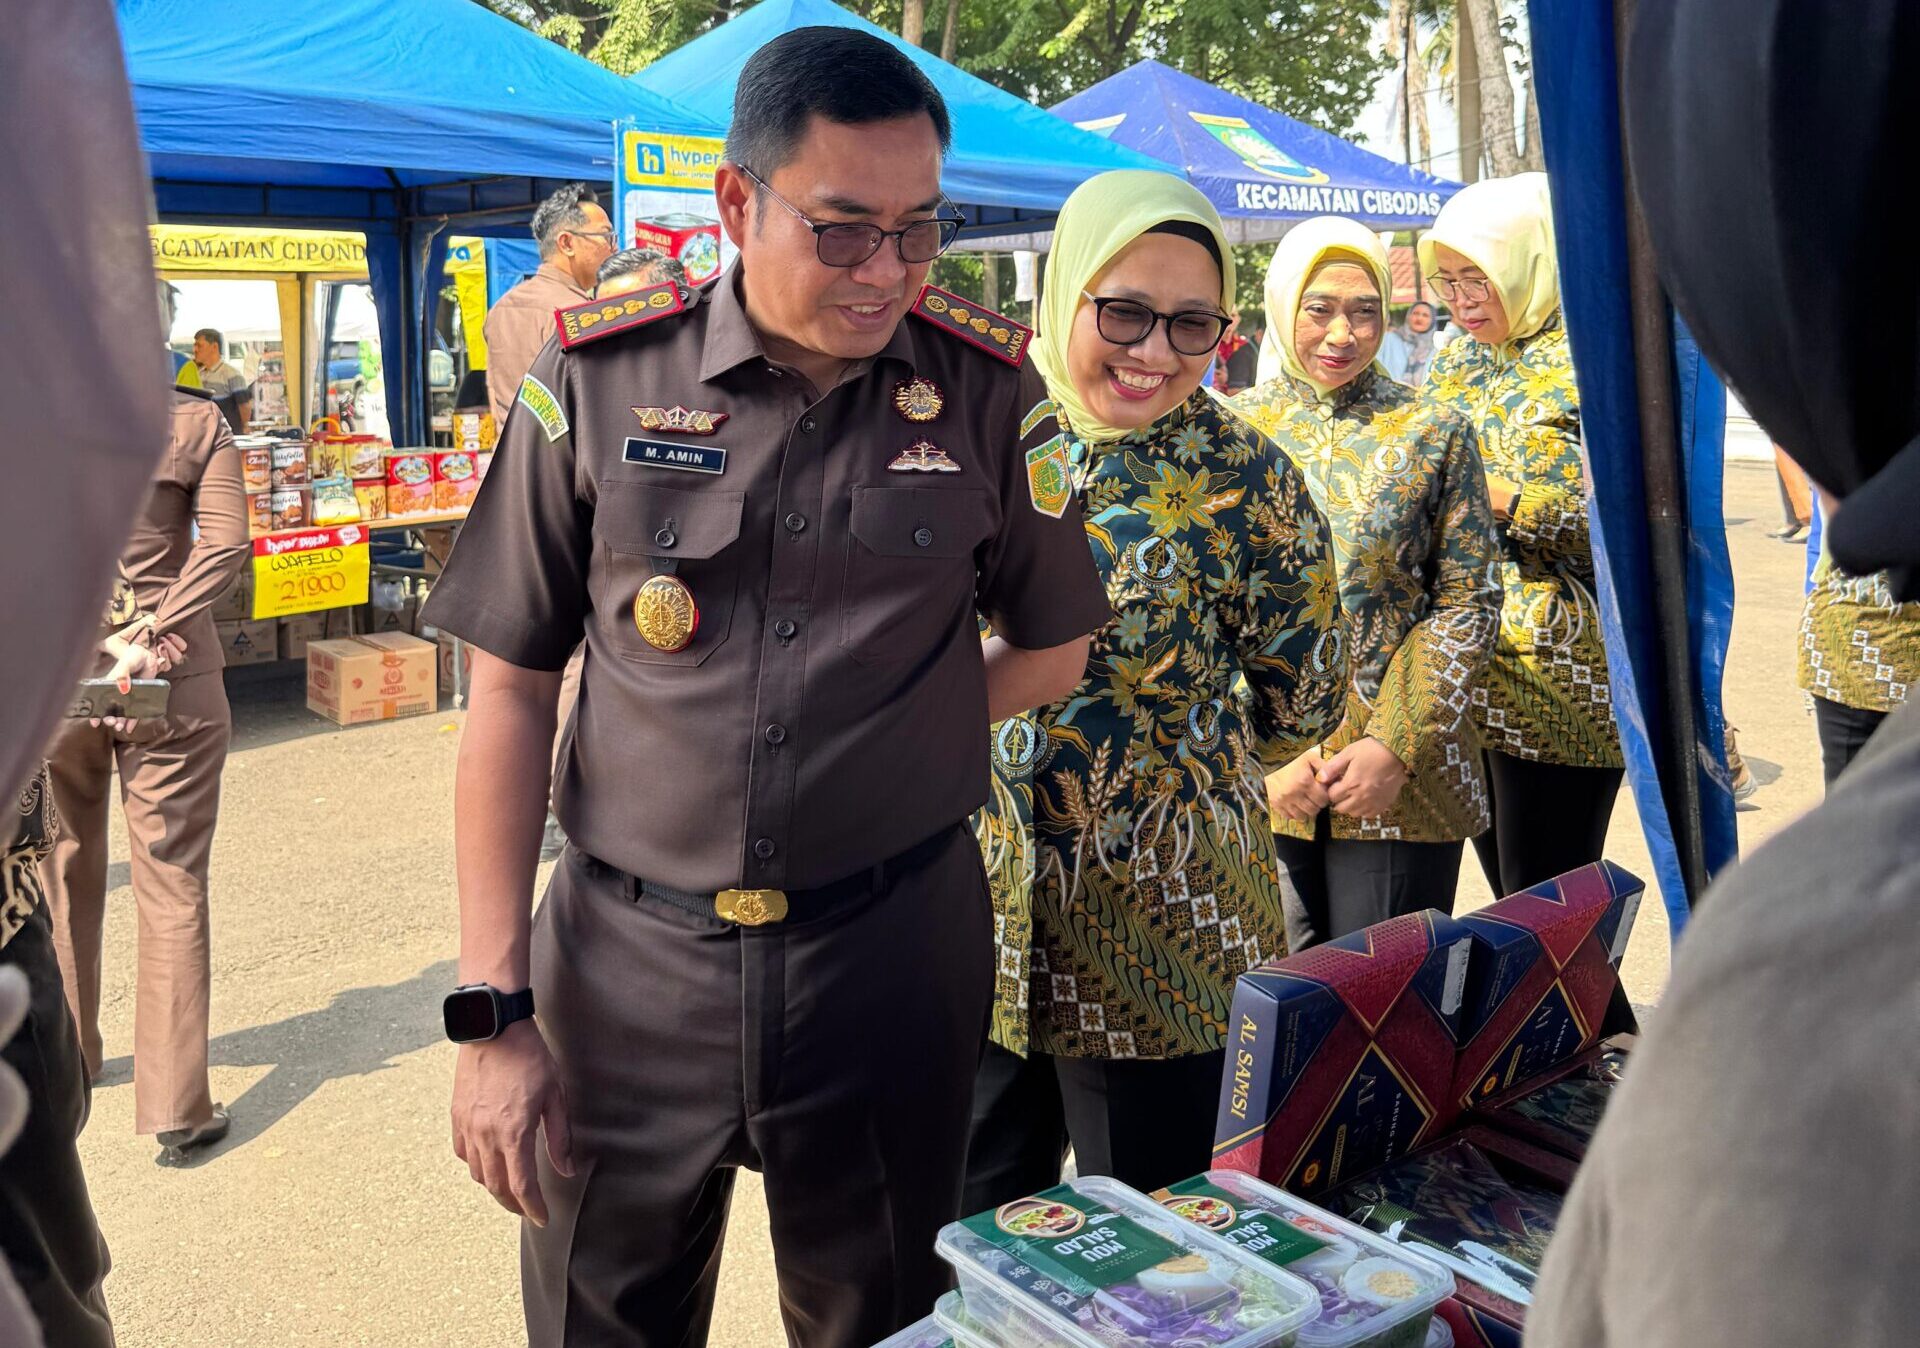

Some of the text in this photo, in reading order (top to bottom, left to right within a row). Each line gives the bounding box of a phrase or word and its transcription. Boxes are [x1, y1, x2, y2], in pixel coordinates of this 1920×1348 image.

[670, 145, 720, 167] hyper
[1235, 183, 1441, 216] KECAMATAN CIBODAS
[562, 311, 581, 341] JAKSA
[1007, 329, 1027, 358] JAKSA
[524, 389, 555, 428] BANTEN
[645, 447, 704, 464] M. AMIN
[281, 571, 346, 601] 21900
[1230, 1013, 1258, 1120] AL SAMSI
[1053, 1226, 1119, 1256] SALAD
[1081, 1239, 1127, 1263] MOU
